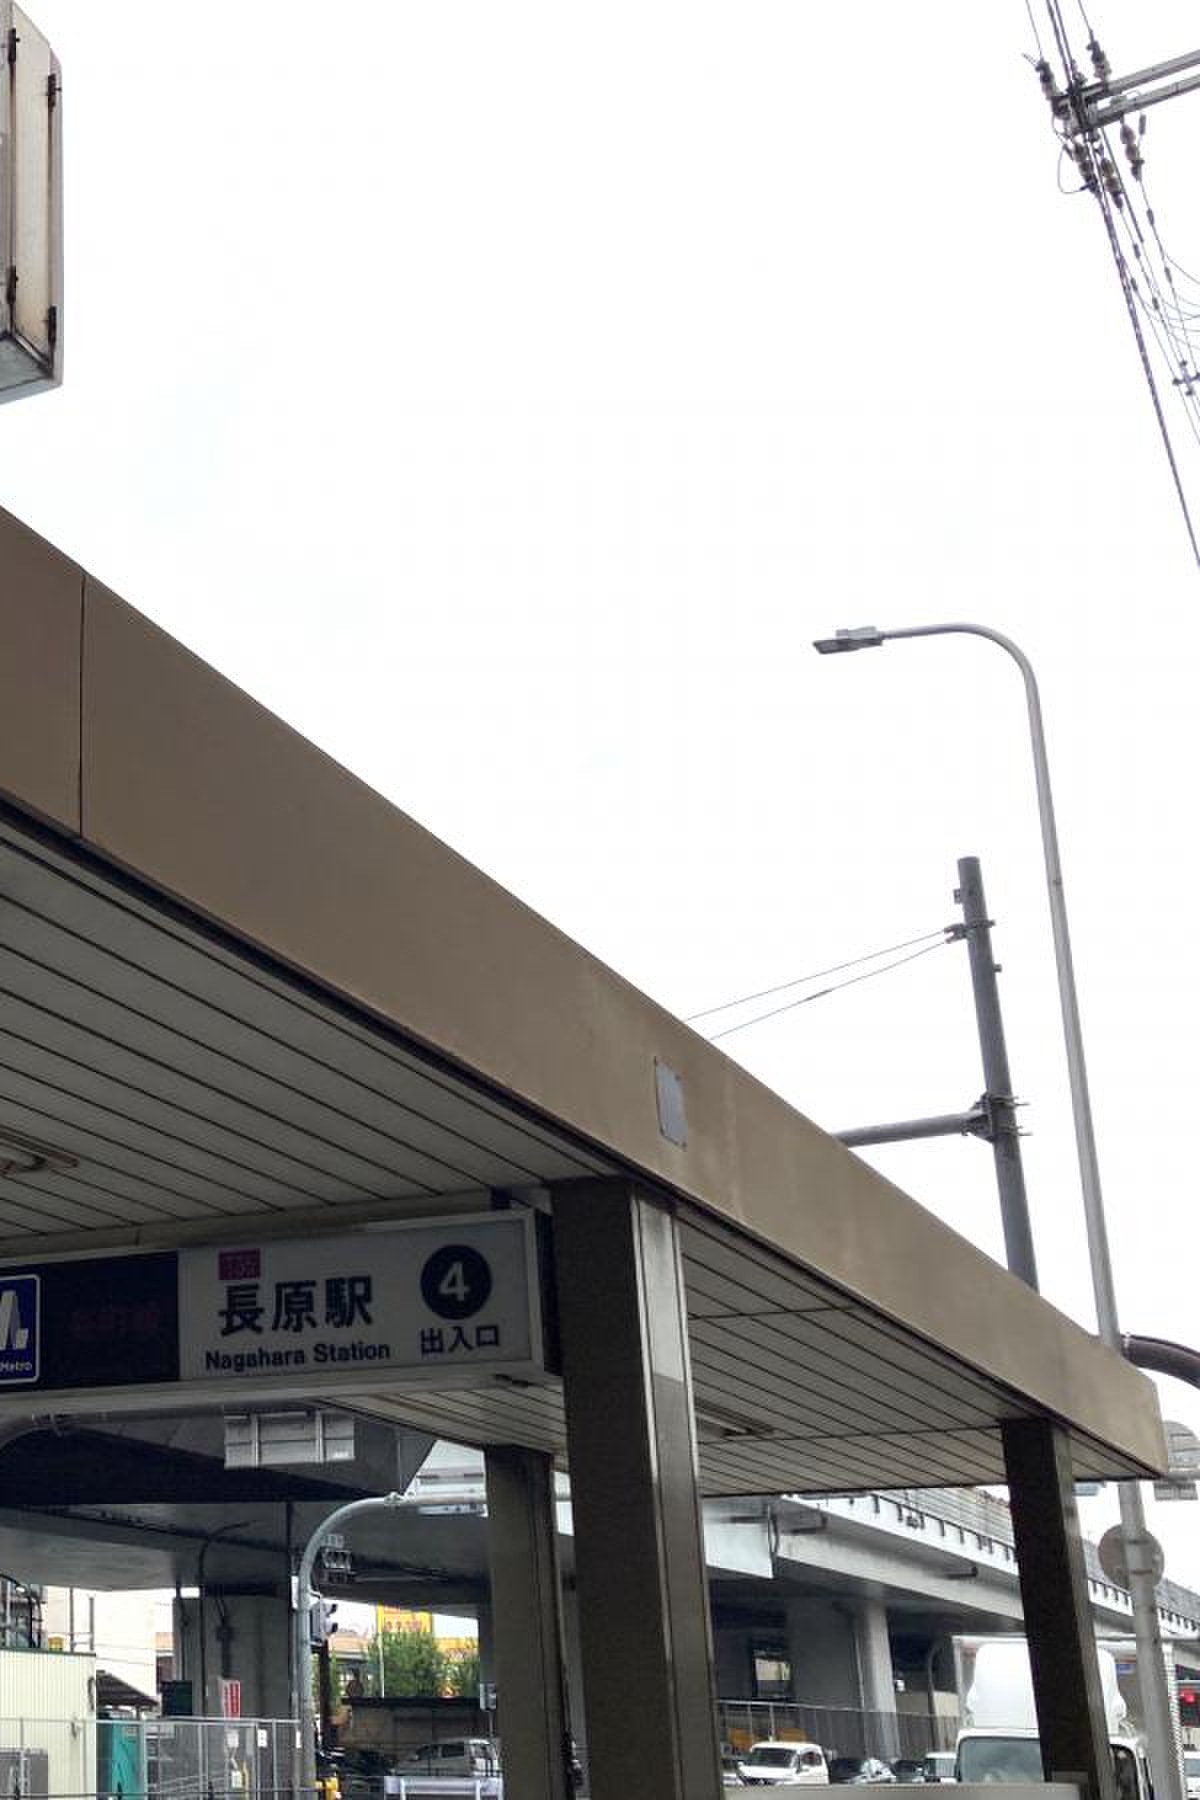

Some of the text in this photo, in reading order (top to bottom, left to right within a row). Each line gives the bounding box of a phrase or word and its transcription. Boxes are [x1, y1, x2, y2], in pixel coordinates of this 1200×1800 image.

[438, 1260, 471, 1302] 4
[217, 1275, 374, 1337] 長原駅
[205, 1340, 391, 1373] Nagahara Station
[420, 1324, 501, 1355] 出入口
